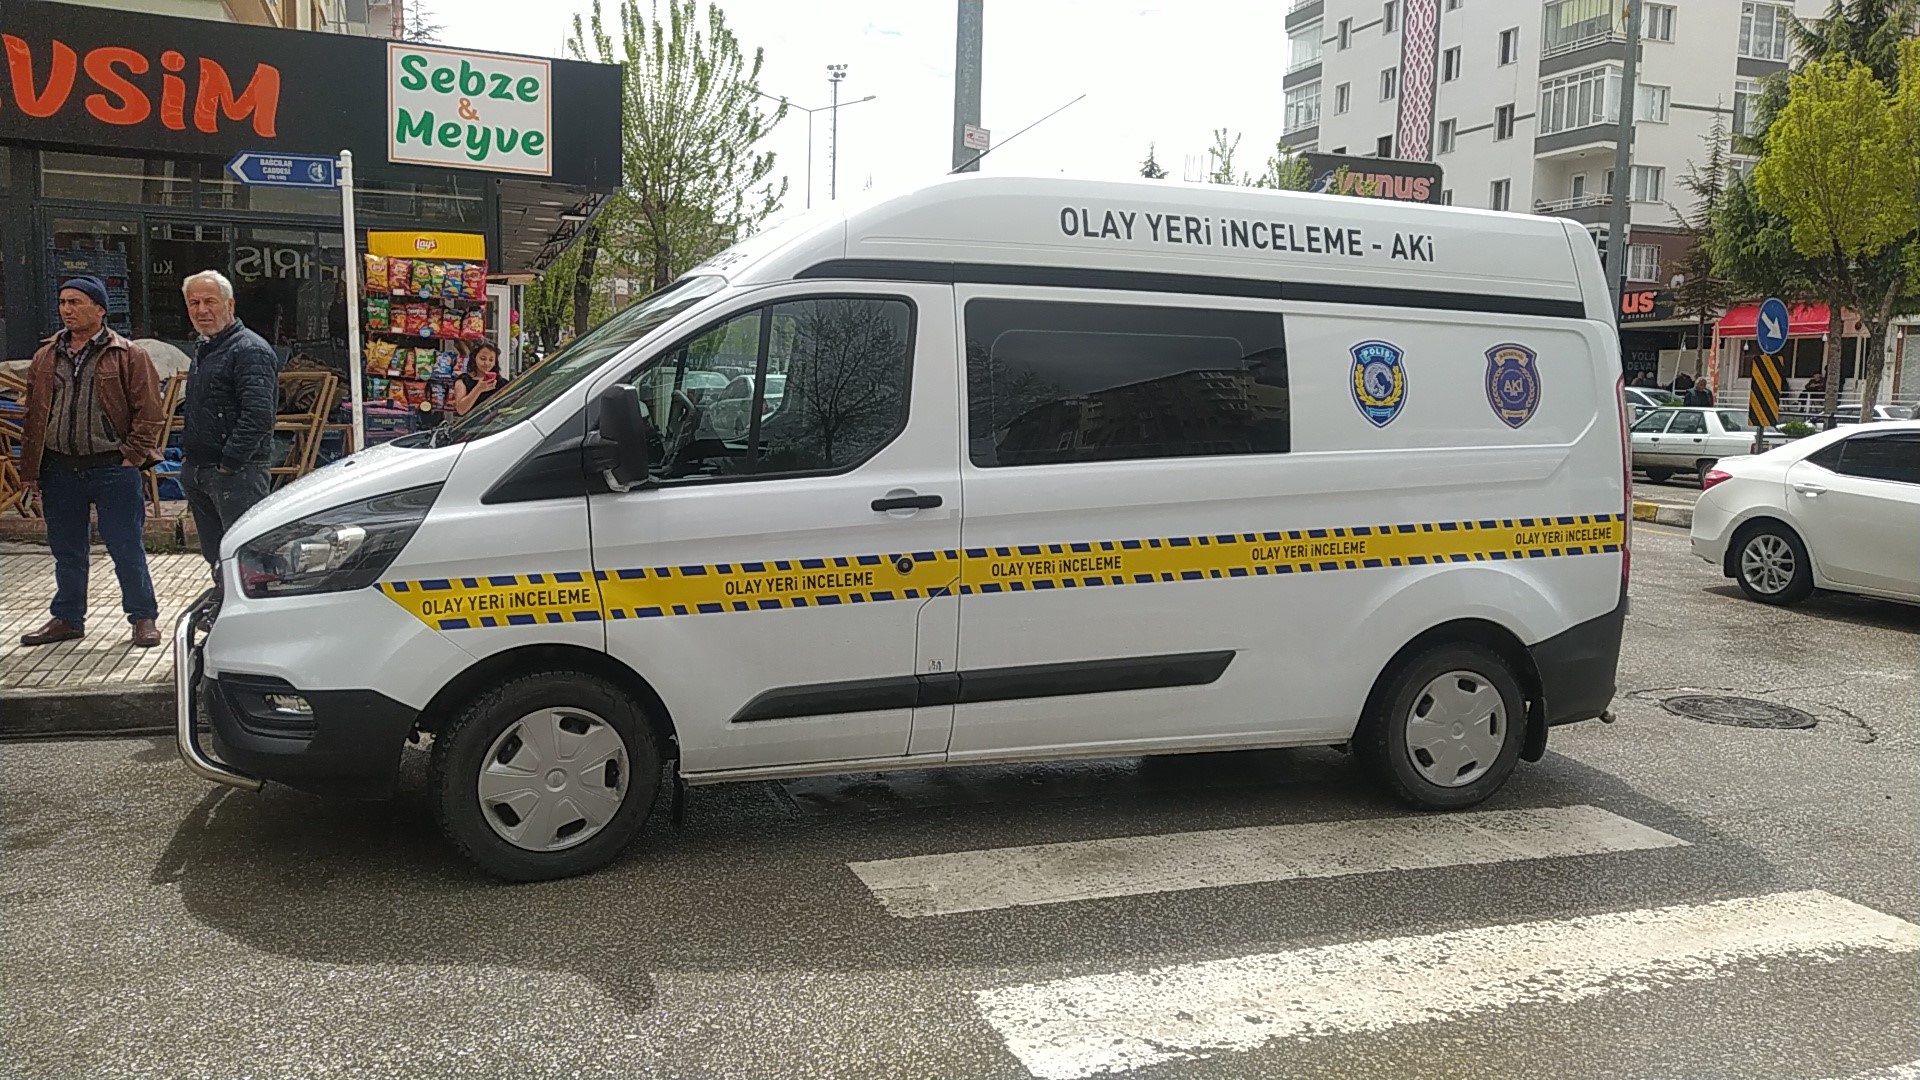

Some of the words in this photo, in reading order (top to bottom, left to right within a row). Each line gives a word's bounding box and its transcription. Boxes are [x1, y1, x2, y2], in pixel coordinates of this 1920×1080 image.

[0, 33, 281, 138] VSiM
[400, 54, 540, 103] Sebze
[458, 97, 480, 121] &
[396, 107, 545, 162] Meyve
[1060, 207, 1137, 240] OLAY
[1515, 533, 1540, 545] OLAY
[1252, 547, 1281, 561] OLAY
[991, 562, 1024, 577] OLAY
[725, 579, 762, 596] OLAY
[422, 598, 463, 616] OLAY
